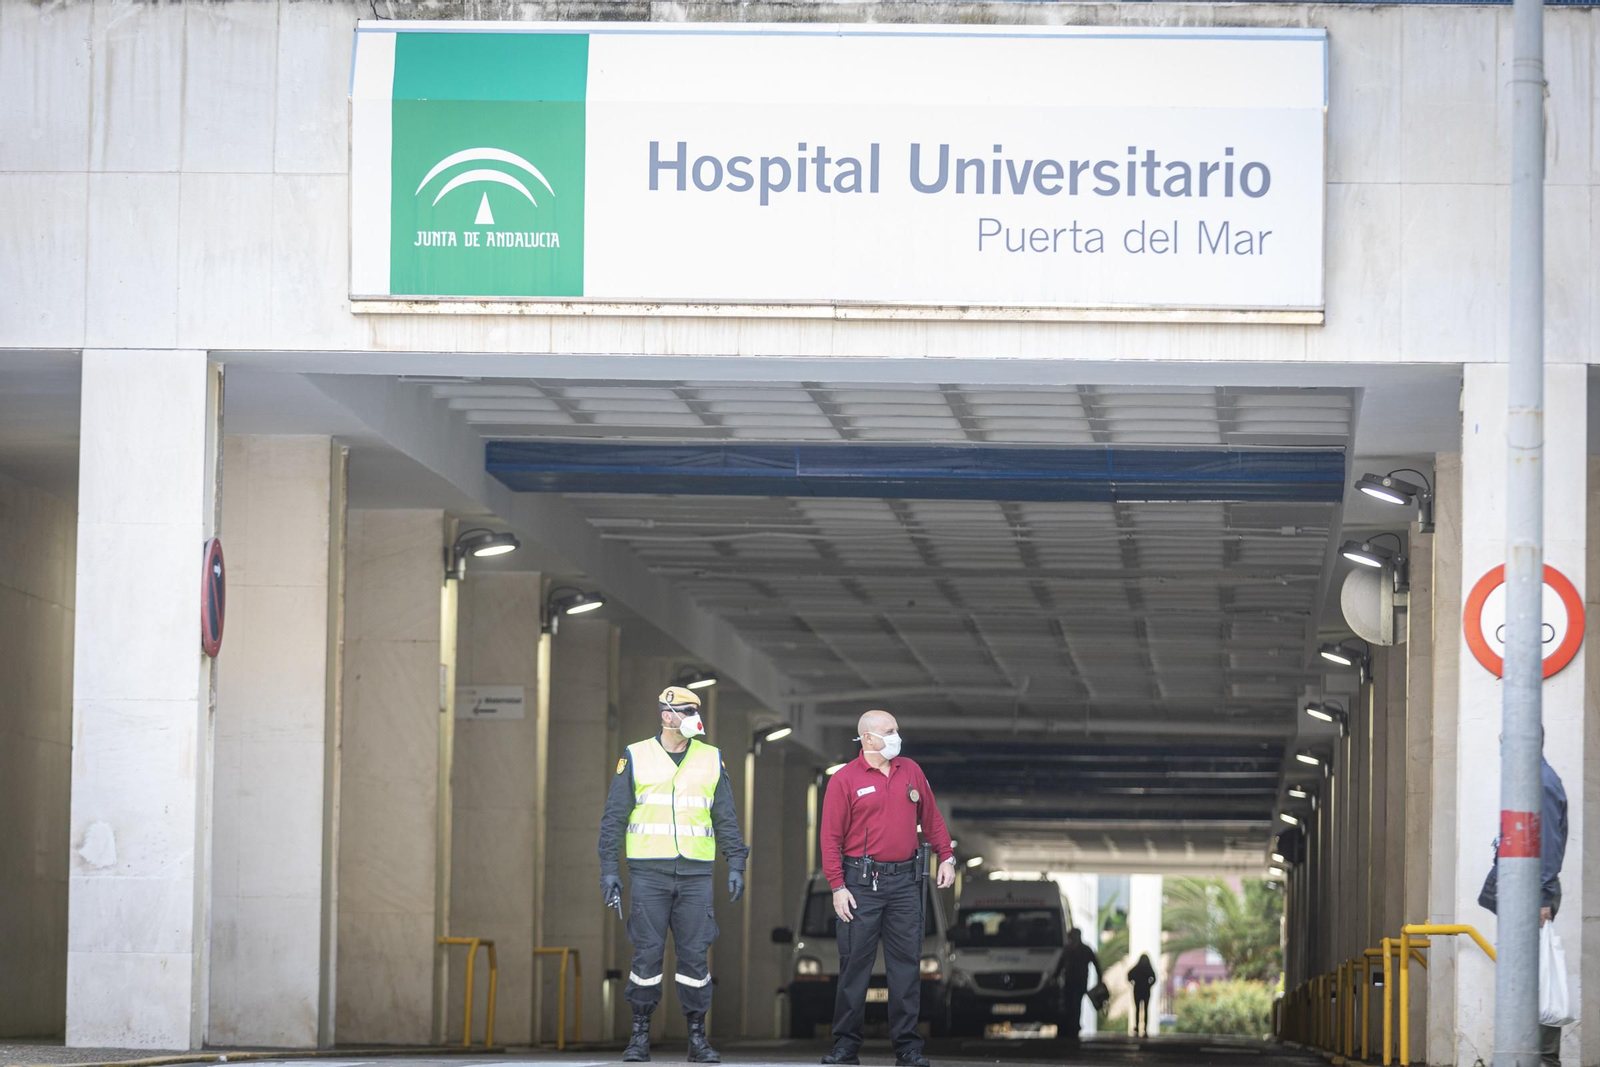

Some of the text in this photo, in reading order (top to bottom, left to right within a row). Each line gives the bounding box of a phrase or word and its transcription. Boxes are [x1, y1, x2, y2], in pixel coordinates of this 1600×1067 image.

[648, 140, 1272, 207] Hospital Universitario
[413, 231, 560, 248] JUNTA DE ANDALUCIA
[978, 217, 1273, 256] Puerta del Mar
